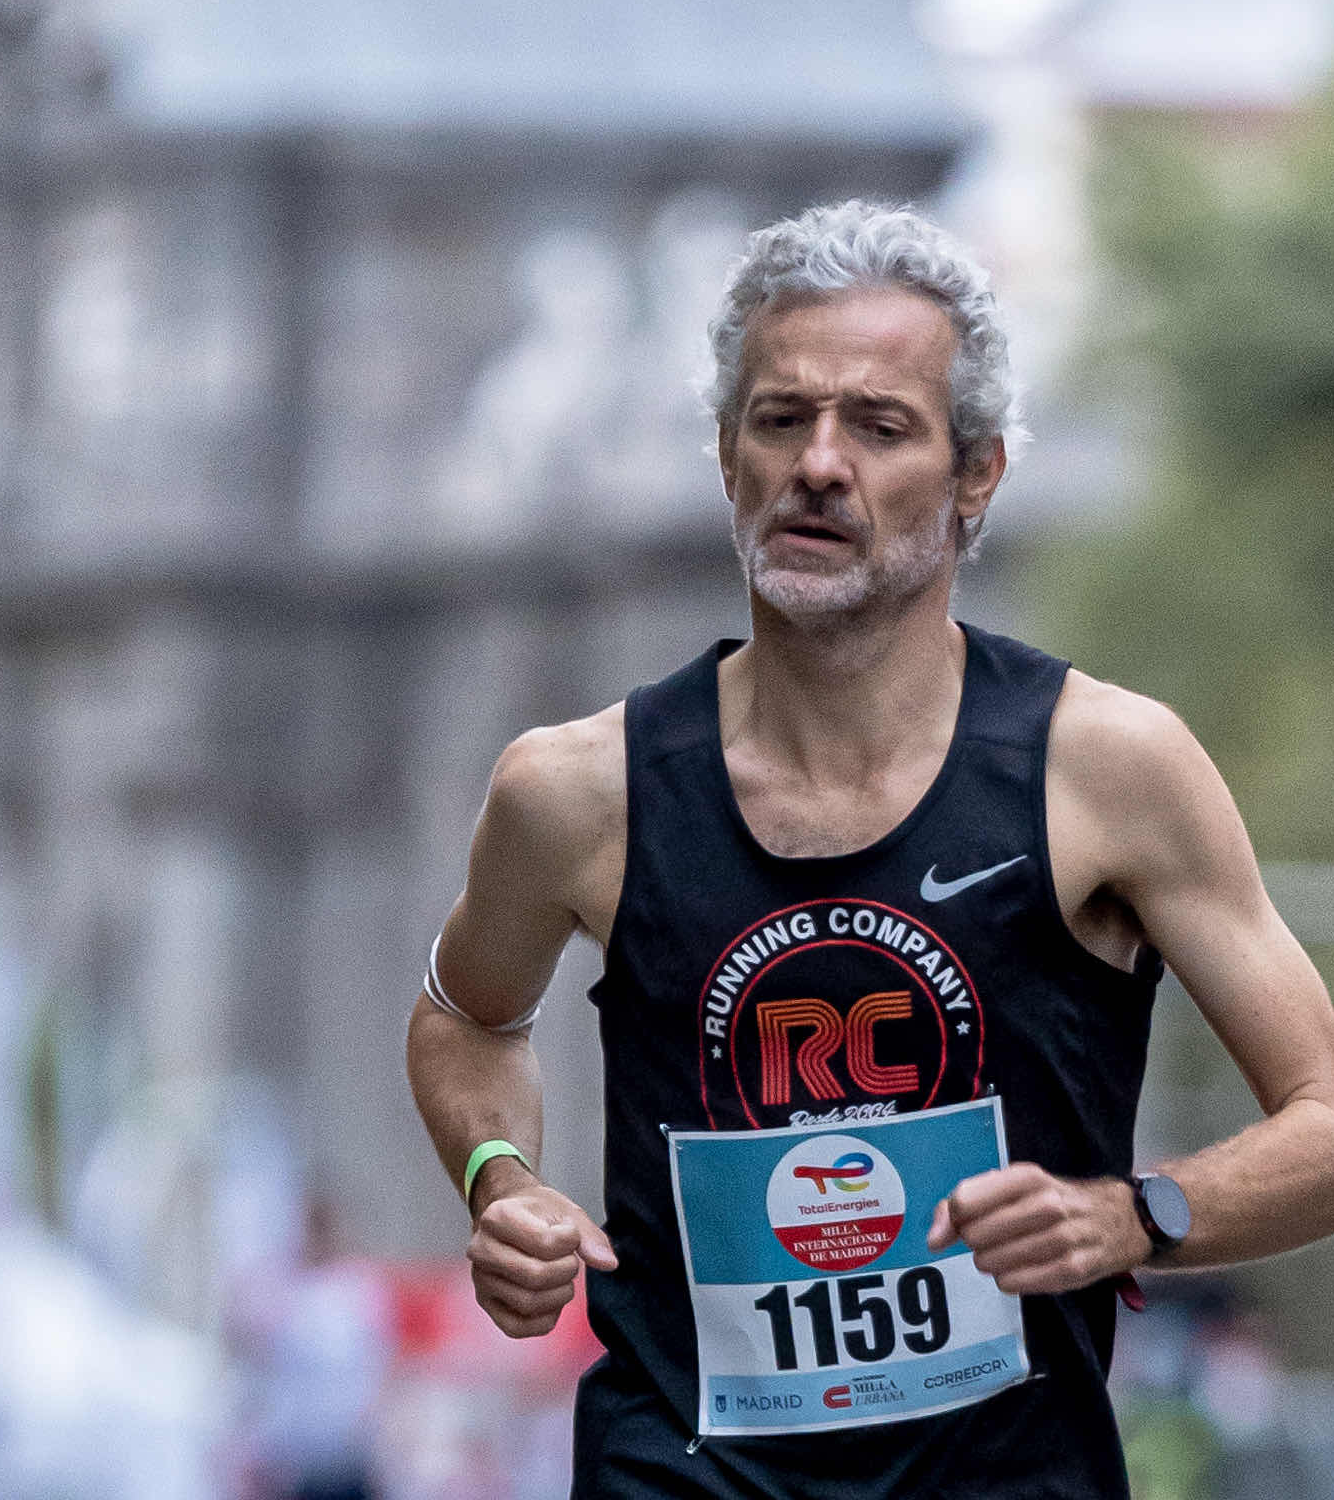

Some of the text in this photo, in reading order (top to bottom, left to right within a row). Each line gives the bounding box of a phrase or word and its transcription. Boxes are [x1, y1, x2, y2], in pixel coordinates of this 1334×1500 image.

[704, 907, 972, 1039] RUNNING COMPANY
[756, 990, 920, 1105] RC
[798, 1198, 880, 1216] TotalEnergies
[821, 1224, 860, 1238] MILLA
[793, 1232, 892, 1252] INTERNACIONAL
[810, 1245, 878, 1262] DE MADRID
[754, 1266, 951, 1371] 1159
[853, 1380, 898, 1393] MILLA
[736, 1394, 803, 1411] MADRID
